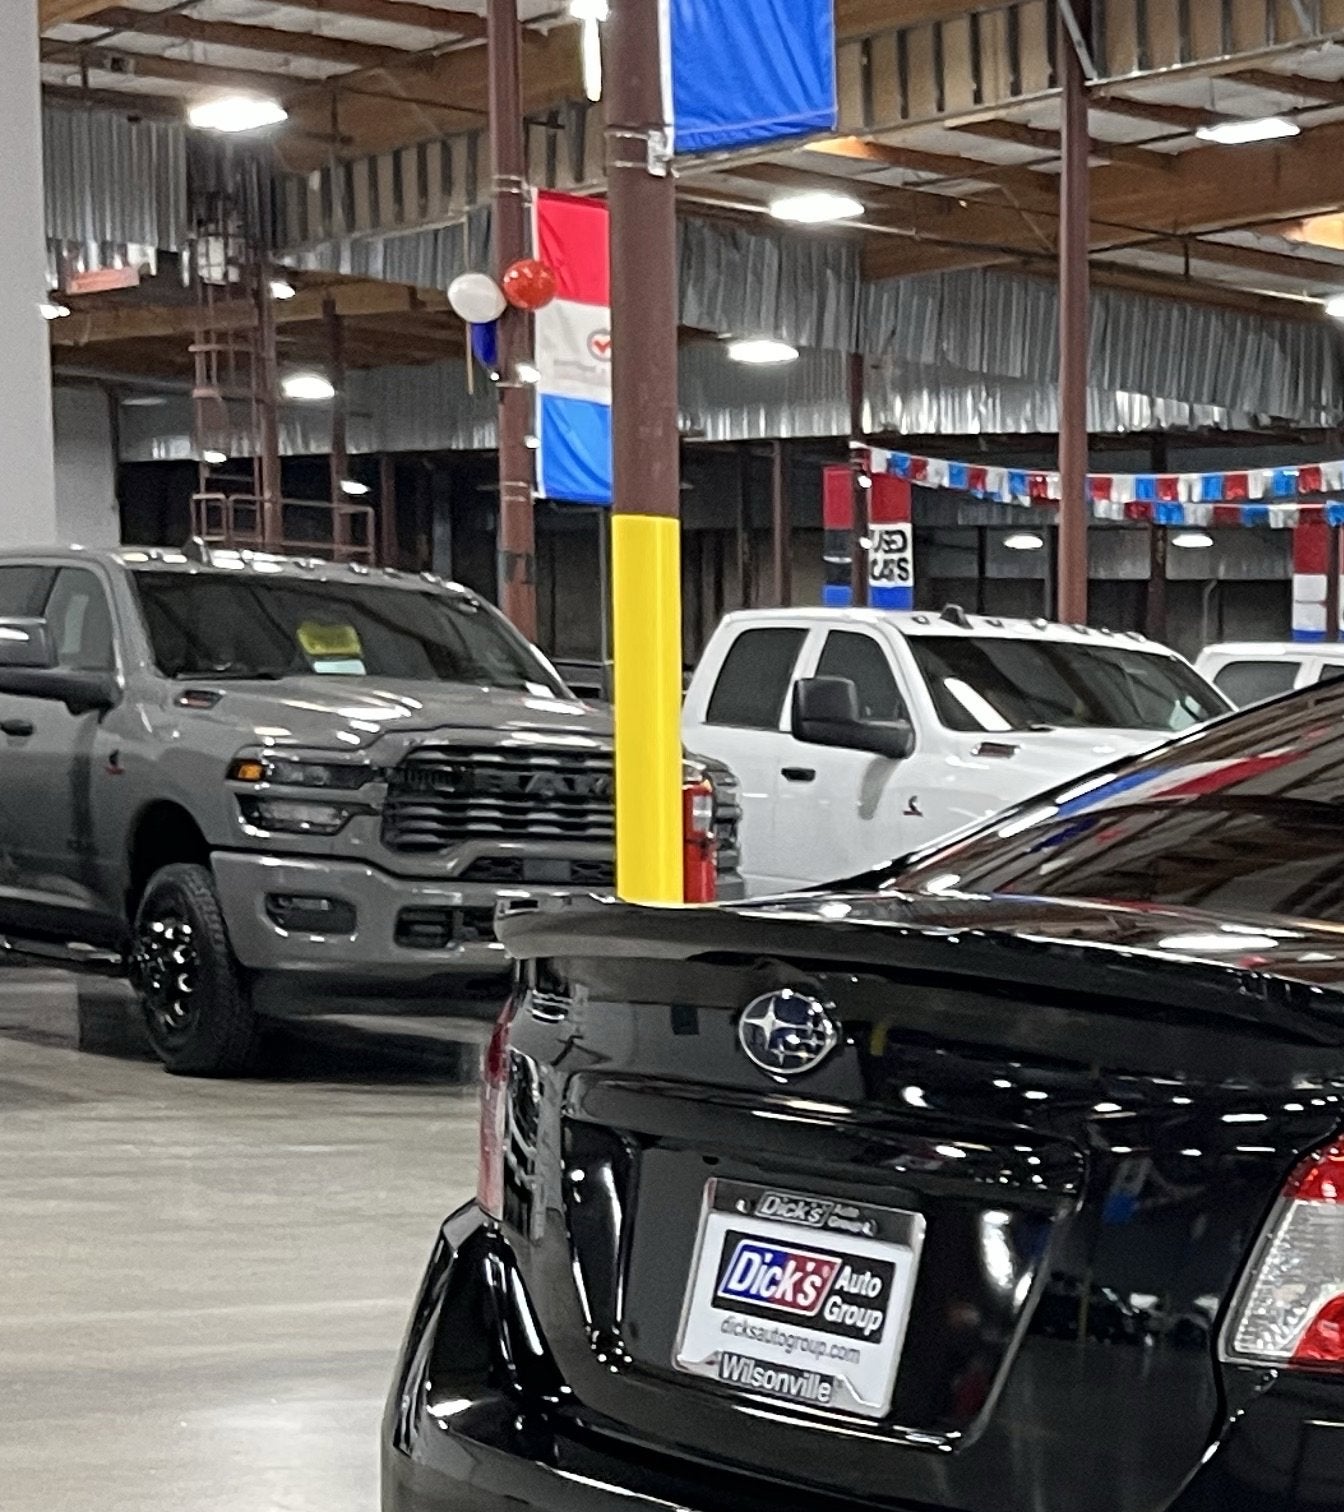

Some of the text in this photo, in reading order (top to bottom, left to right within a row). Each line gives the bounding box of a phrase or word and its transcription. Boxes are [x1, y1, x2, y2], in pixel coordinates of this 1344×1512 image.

[728, 1250, 823, 1306] Dick's
[834, 1265, 883, 1298] Auto
[823, 1295, 884, 1336] Group
[720, 1316, 861, 1364] dicksautogroup.com
[722, 1354, 832, 1402] Wilsonville
